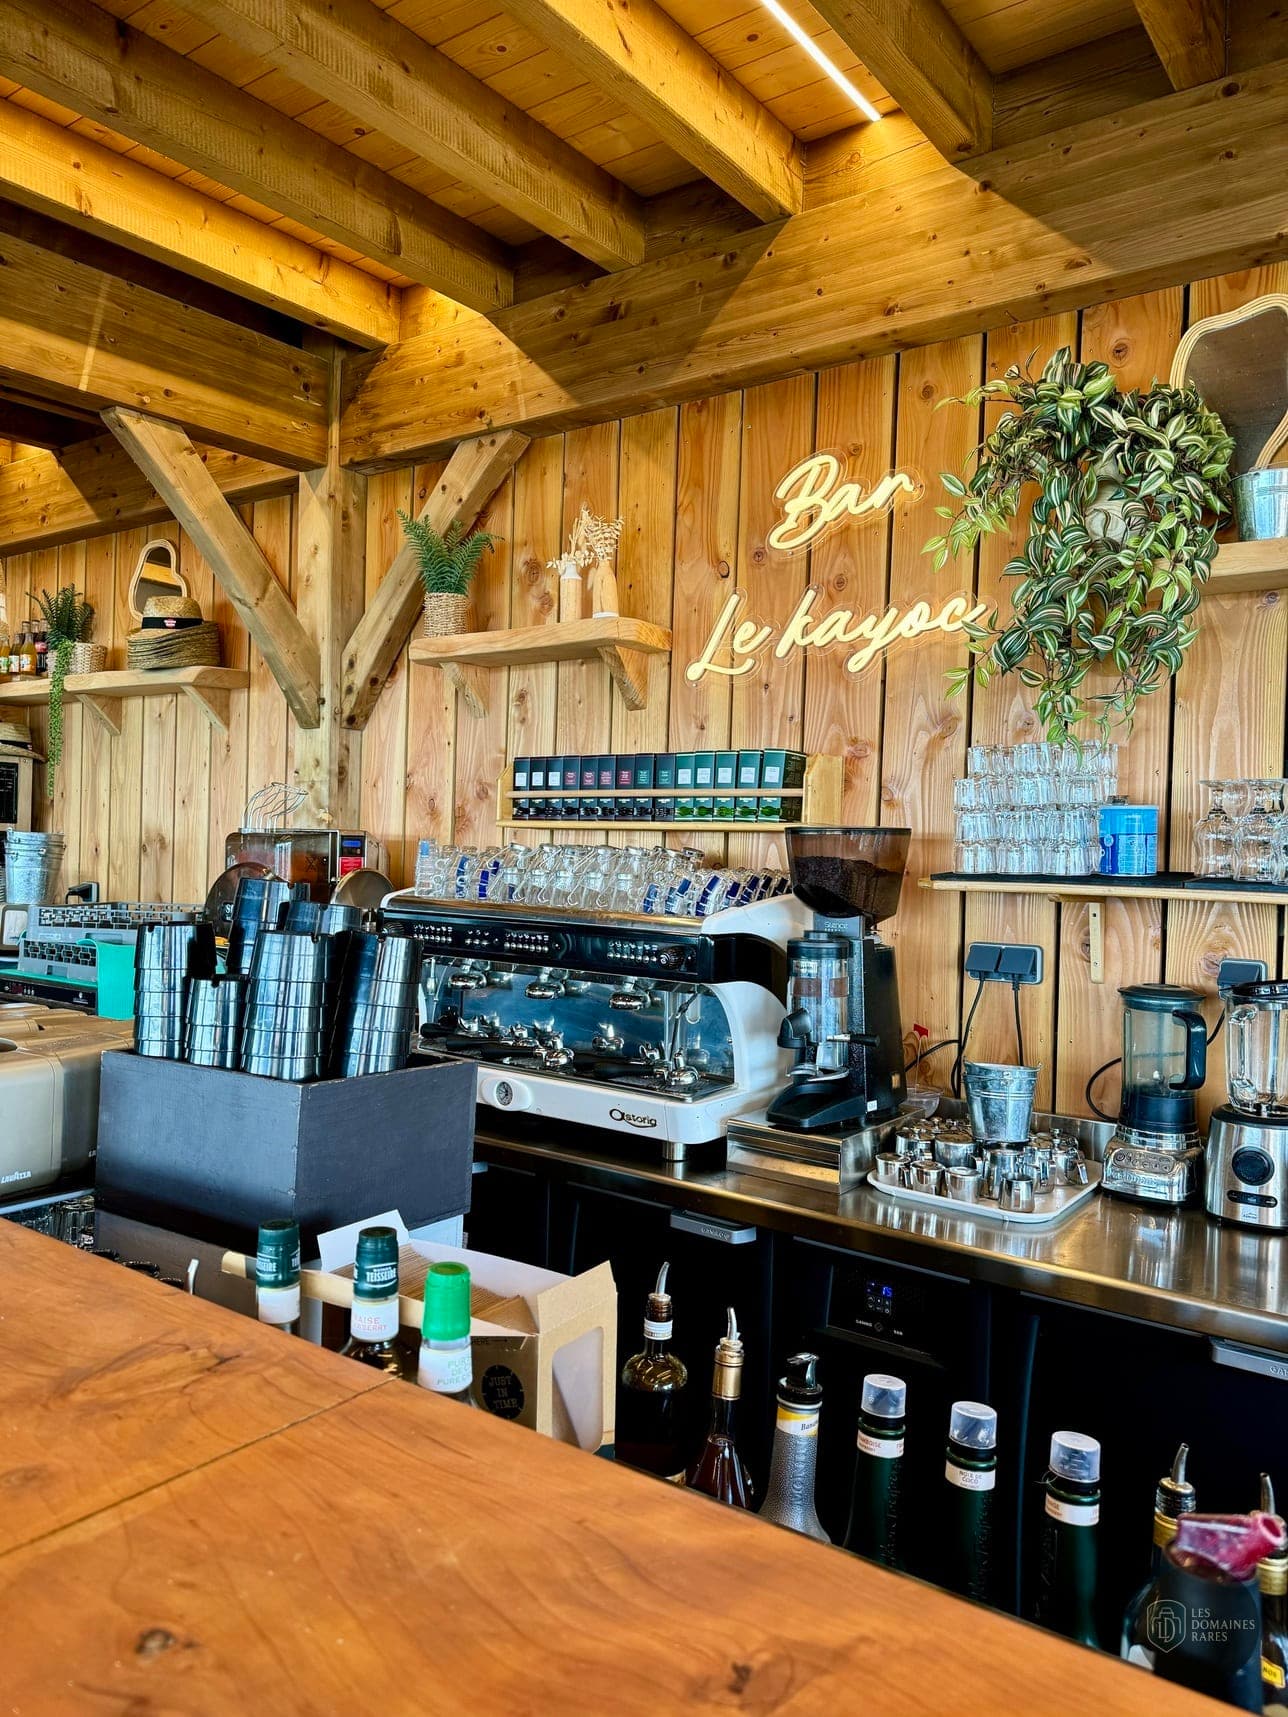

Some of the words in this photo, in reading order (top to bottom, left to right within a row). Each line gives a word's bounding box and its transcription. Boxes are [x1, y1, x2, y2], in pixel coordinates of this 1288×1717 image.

[769, 453, 914, 550] Bar
[686, 593, 773, 681] Le
[775, 588, 988, 673] kayoc
[488, 1376, 511, 1387] JUST
[496, 1387, 508, 1398] IN
[492, 1398, 518, 1409] TIME
